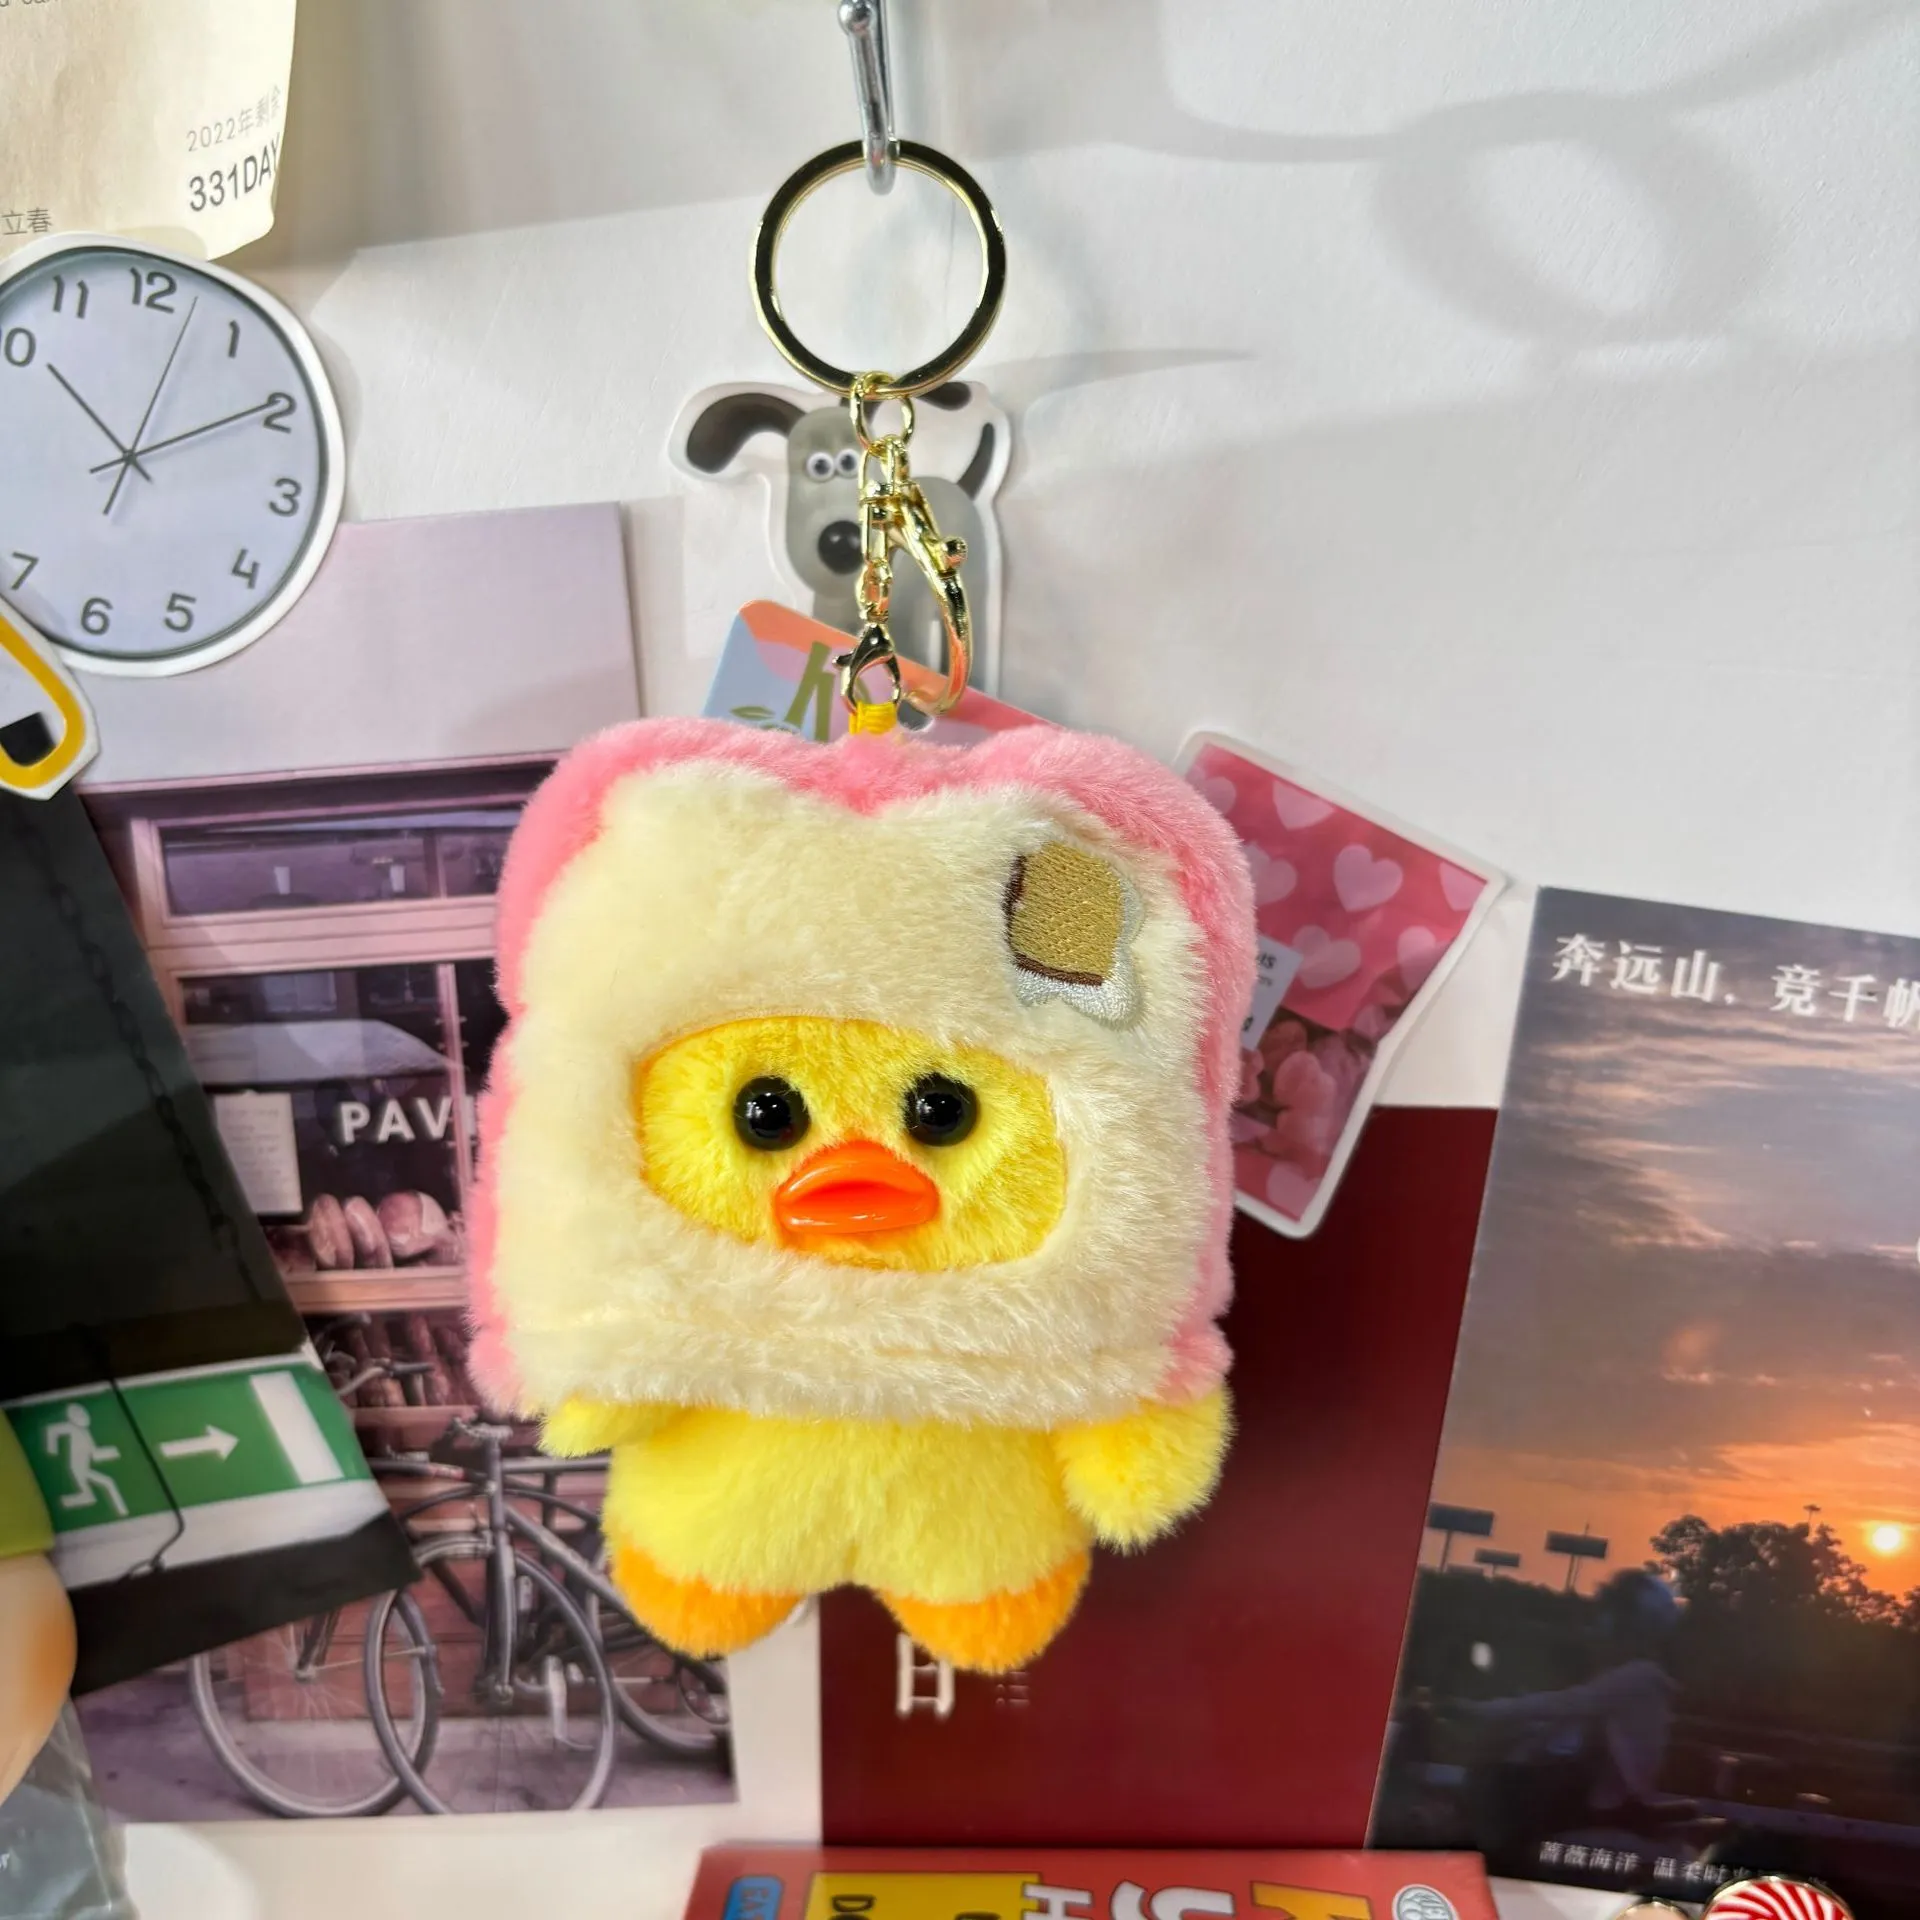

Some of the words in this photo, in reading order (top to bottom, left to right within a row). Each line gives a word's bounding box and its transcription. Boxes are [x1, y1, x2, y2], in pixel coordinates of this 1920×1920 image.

[2, 207, 53, 235] 立春
[52, 274, 90, 319] 11
[130, 267, 178, 314] 12
[2, 326, 37, 368] 0
[226, 319, 241, 358] 1
[262, 391, 297, 433] 2
[268, 478, 302, 517] 3
[10, 551, 39, 591] 7
[231, 548, 260, 590] 4
[80, 597, 114, 636] 6
[163, 592, 196, 633] 5
